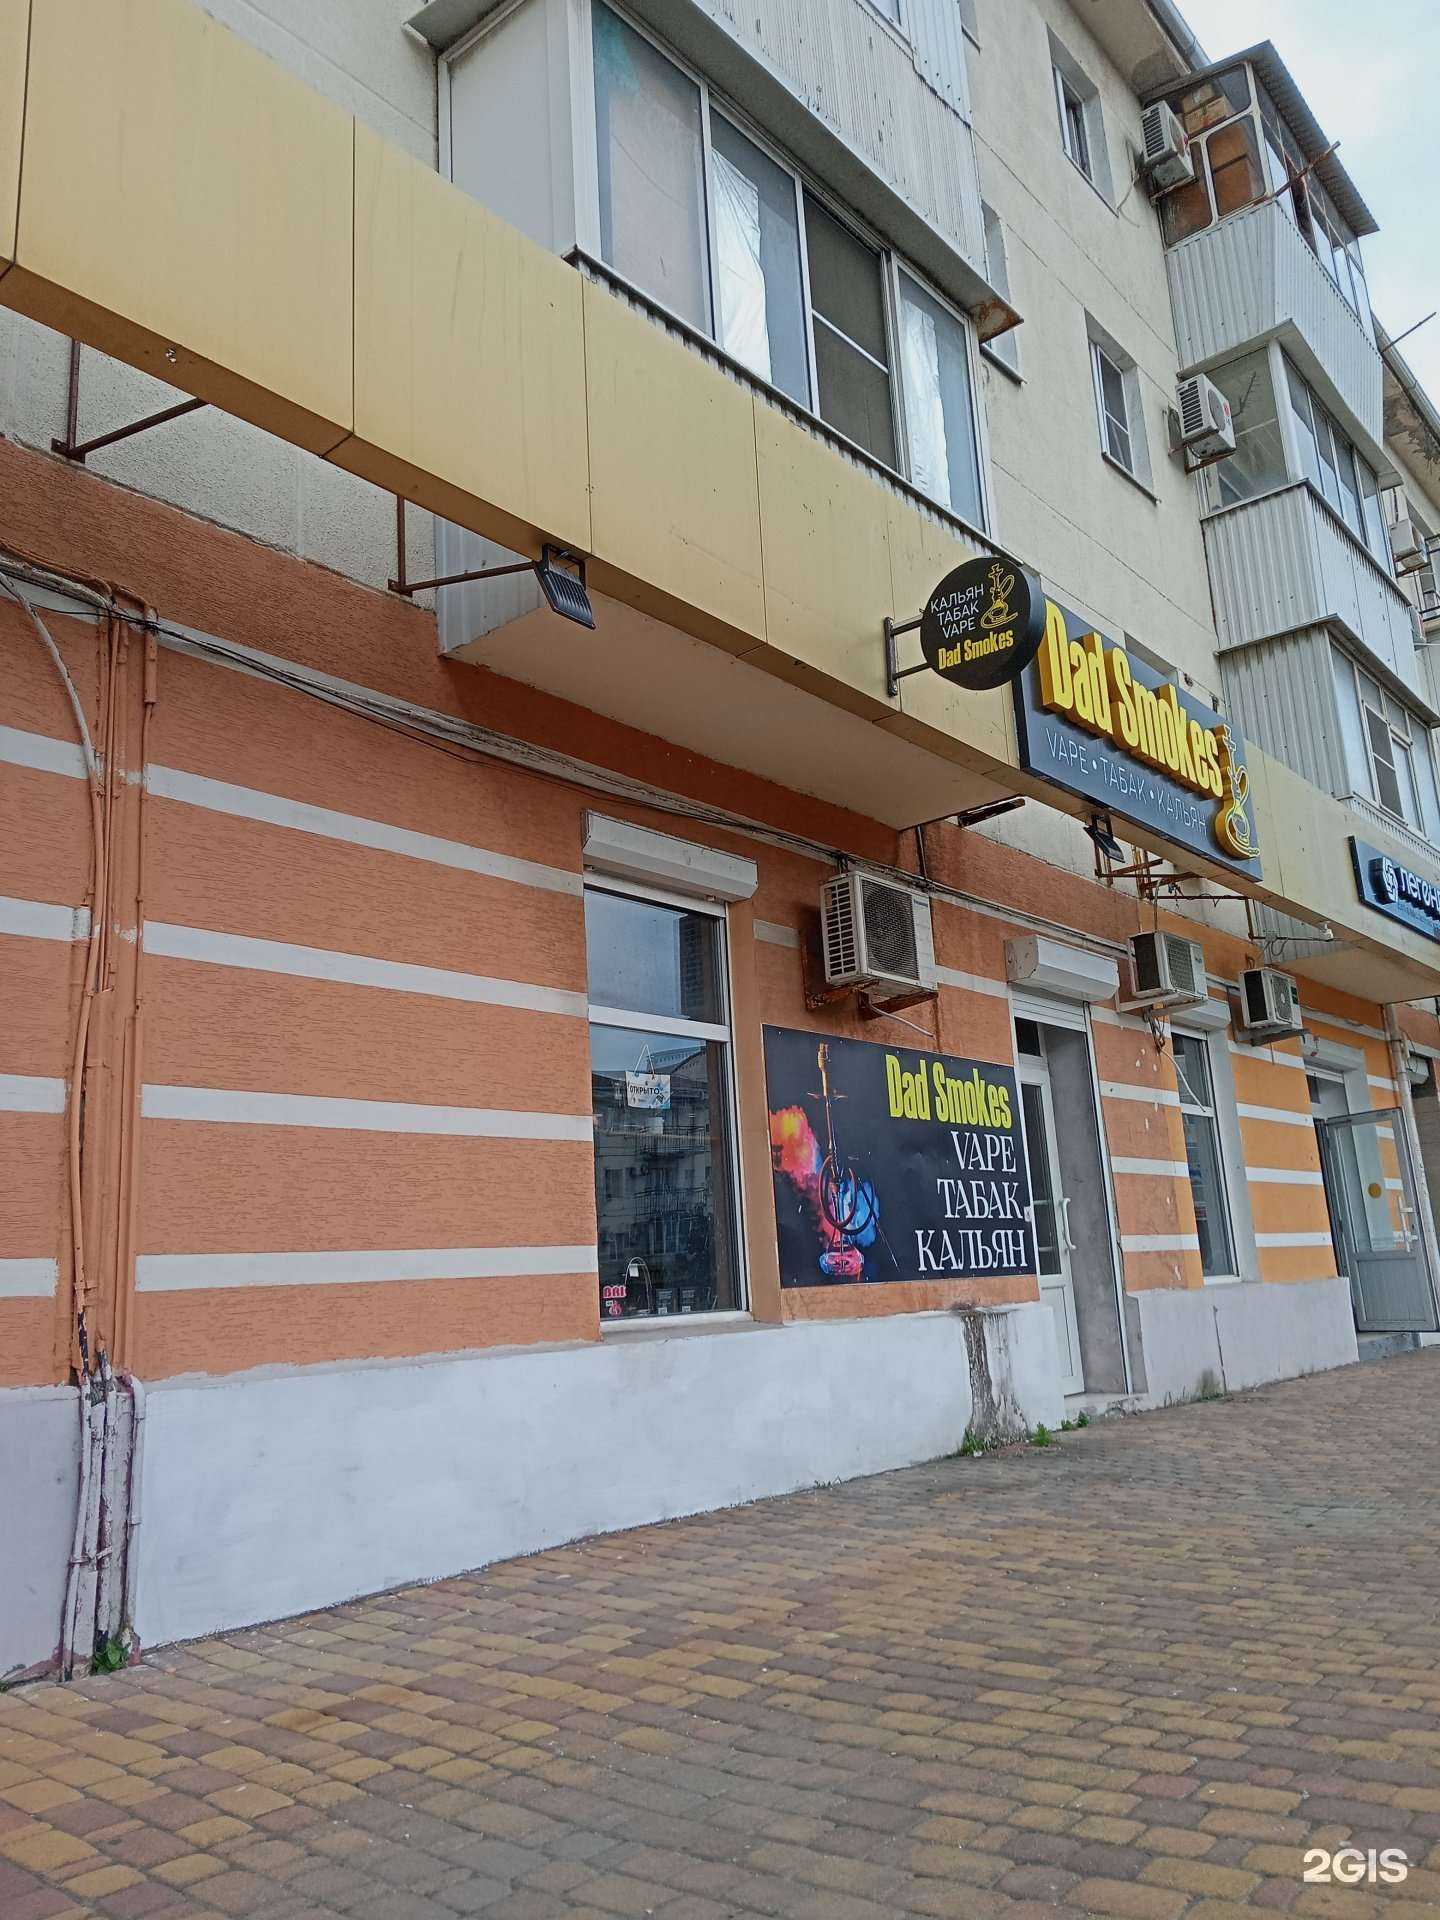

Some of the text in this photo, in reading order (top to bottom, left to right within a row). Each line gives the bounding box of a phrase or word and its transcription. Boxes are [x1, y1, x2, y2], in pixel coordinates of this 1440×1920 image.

[930, 583, 984, 614] КАЛЬЯН
[937, 601, 979, 626] ТАБАК
[942, 617, 976, 639] VAPE
[938, 630, 1014, 670] Dad Smokes
[1041, 599, 1224, 798] Dad Smokes
[1045, 727, 1207, 836] VAPE ТАБАК КАЛЬЯН
[629, 1084, 660, 1096] ОТКРЫТО
[885, 1054, 1013, 1129] Dad Smokes
[950, 1130, 1017, 1173] VAPE
[936, 1178, 1023, 1219] ТАБАК
[914, 1229, 1029, 1272] КАЛЬЯН
